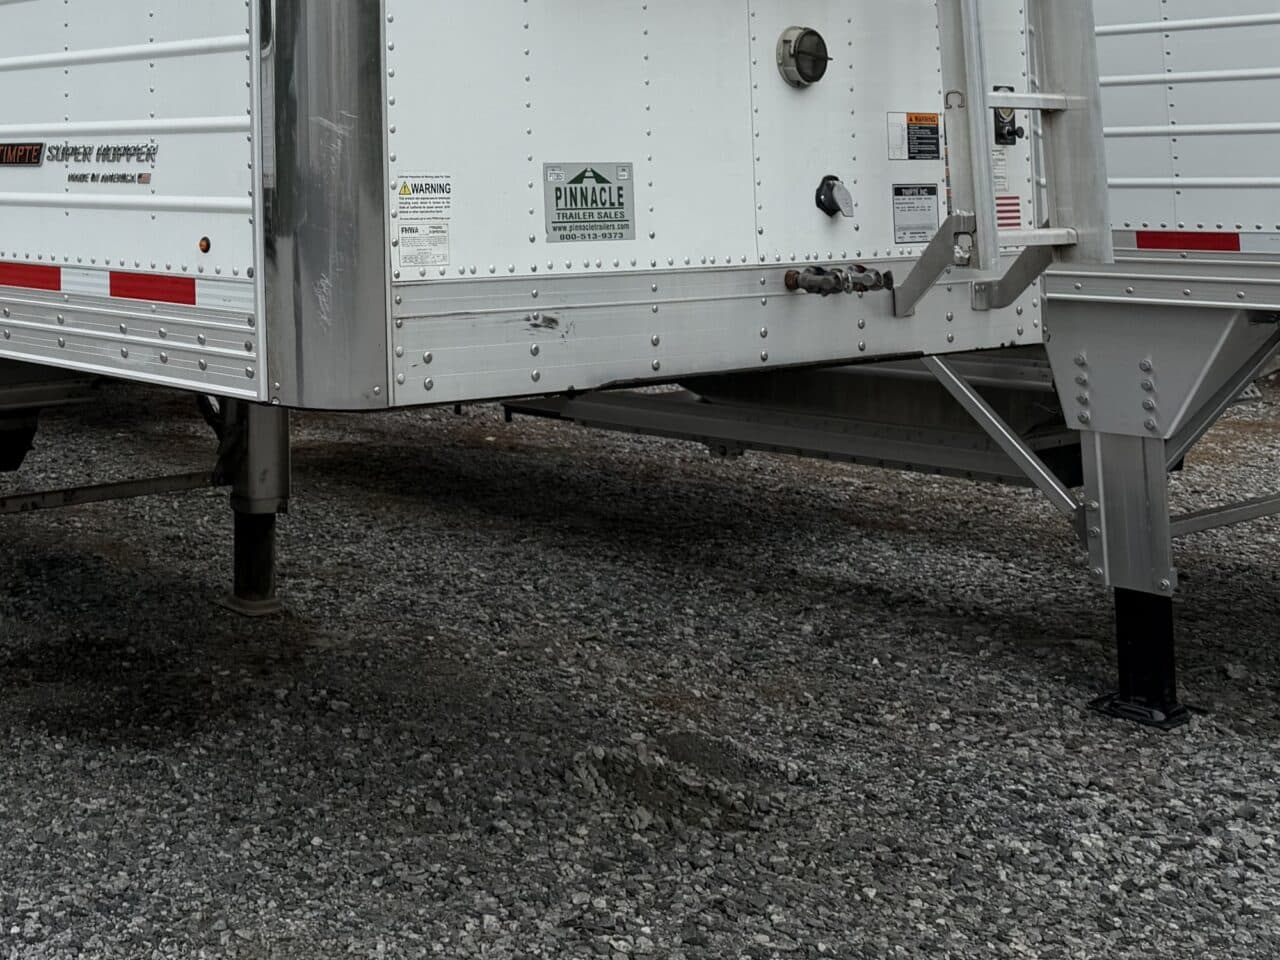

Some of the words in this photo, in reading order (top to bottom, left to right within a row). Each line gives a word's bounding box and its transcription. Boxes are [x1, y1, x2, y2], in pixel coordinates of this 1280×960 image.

[46, 144, 94, 163] SUPER
[96, 142, 158, 163] HOPPER
[411, 183, 451, 194] WARNING
[555, 186, 624, 208] PINNACLE
[556, 211, 594, 220] TRAILER
[597, 210, 625, 219] SALES
[552, 223, 629, 232] www.pinnacletrailers.com
